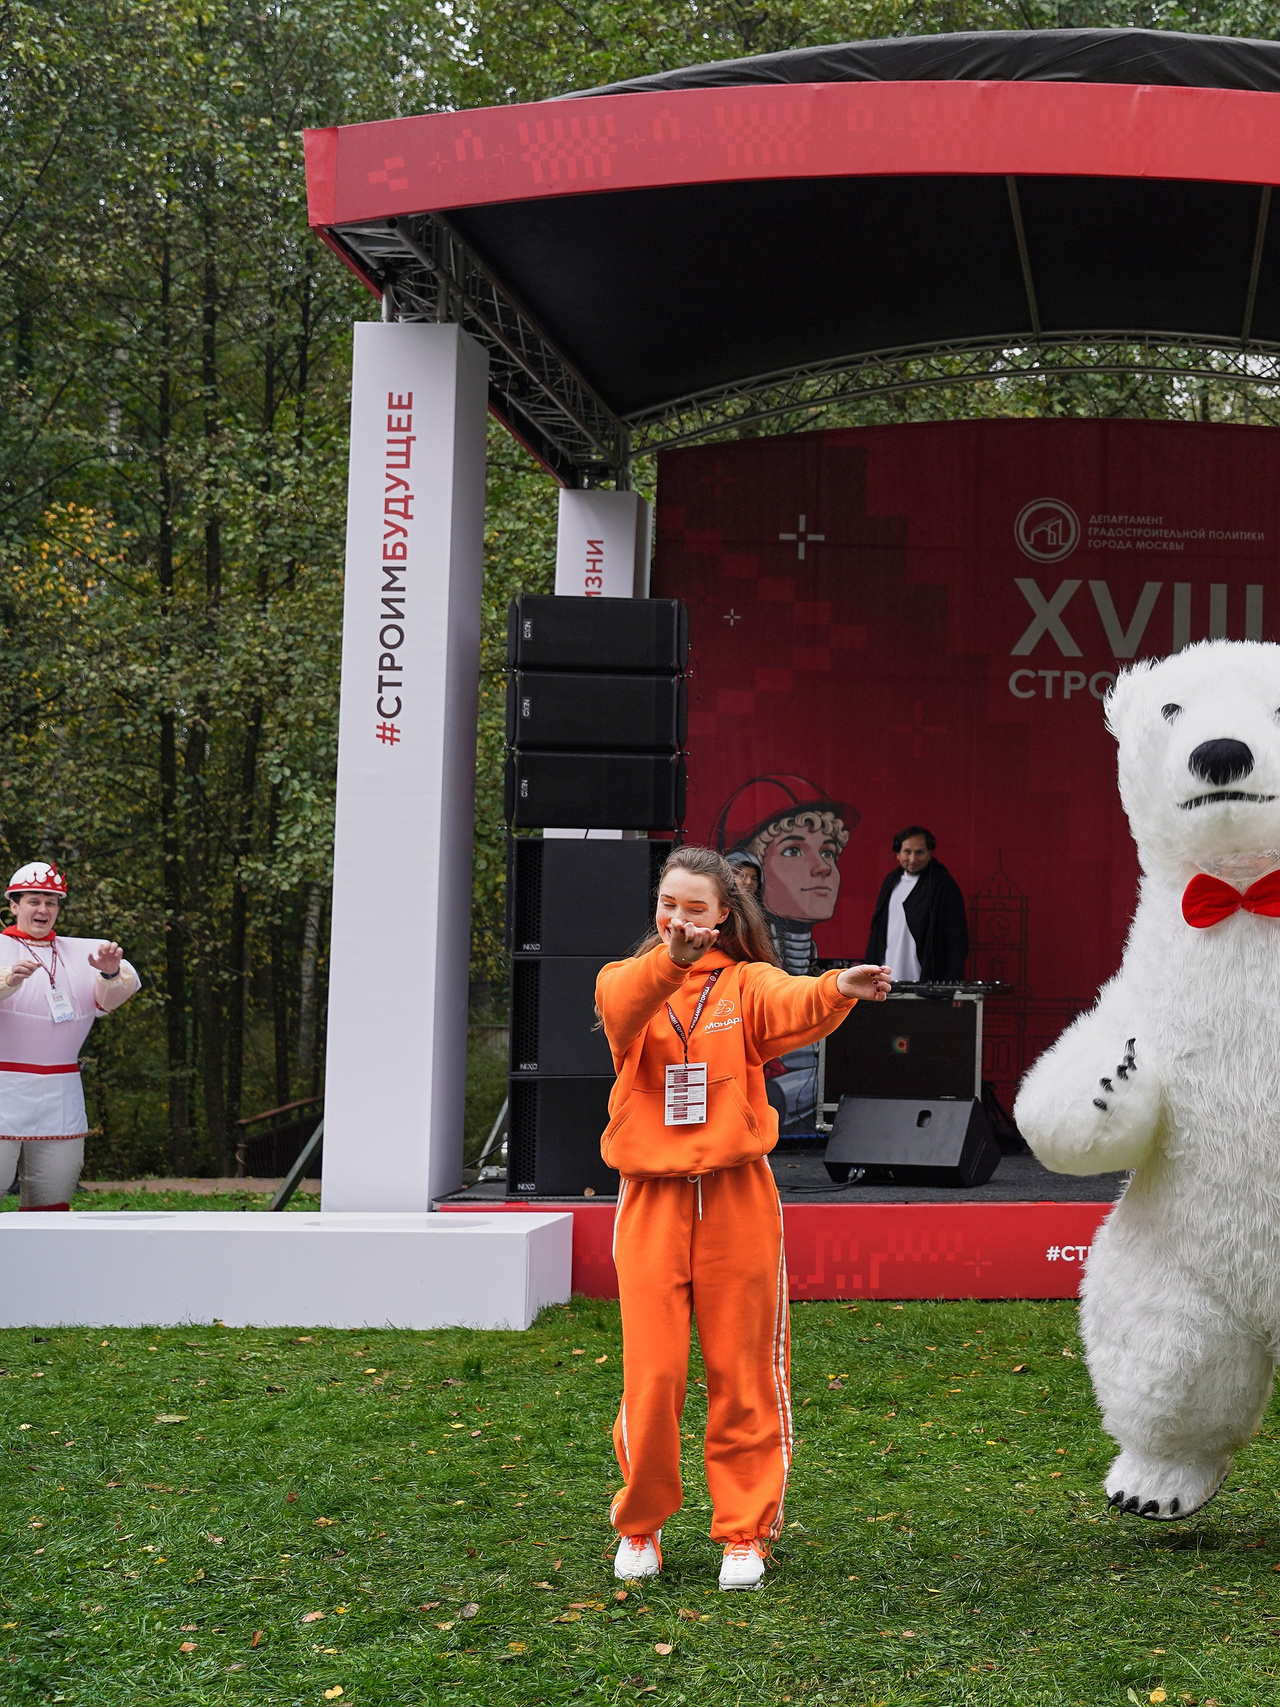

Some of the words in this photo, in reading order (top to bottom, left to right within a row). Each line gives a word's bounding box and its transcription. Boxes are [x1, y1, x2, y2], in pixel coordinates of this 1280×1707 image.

[1088, 515, 1164, 525] ДЕПАРТАМЕНТ
[1088, 527, 1206, 539] ГРАДОСТРОИТЕЛЬНОЙ
[1208, 530, 1265, 541] ПОЛИТИКИ
[1088, 539, 1133, 549] ГОРОДА
[1135, 541, 1184, 550] МОСКВЫ
[376, 392, 416, 746] #СТРОИМБУДУЩЕЕ
[1010, 578, 1264, 658] XVIII
[1008, 669, 1117, 699] СТРО
[522, 943, 541, 951] NEXO
[519, 1062, 538, 1070] NEXO
[517, 1183, 536, 1191] NEXO
[1045, 1245, 1093, 1261] #СТ
